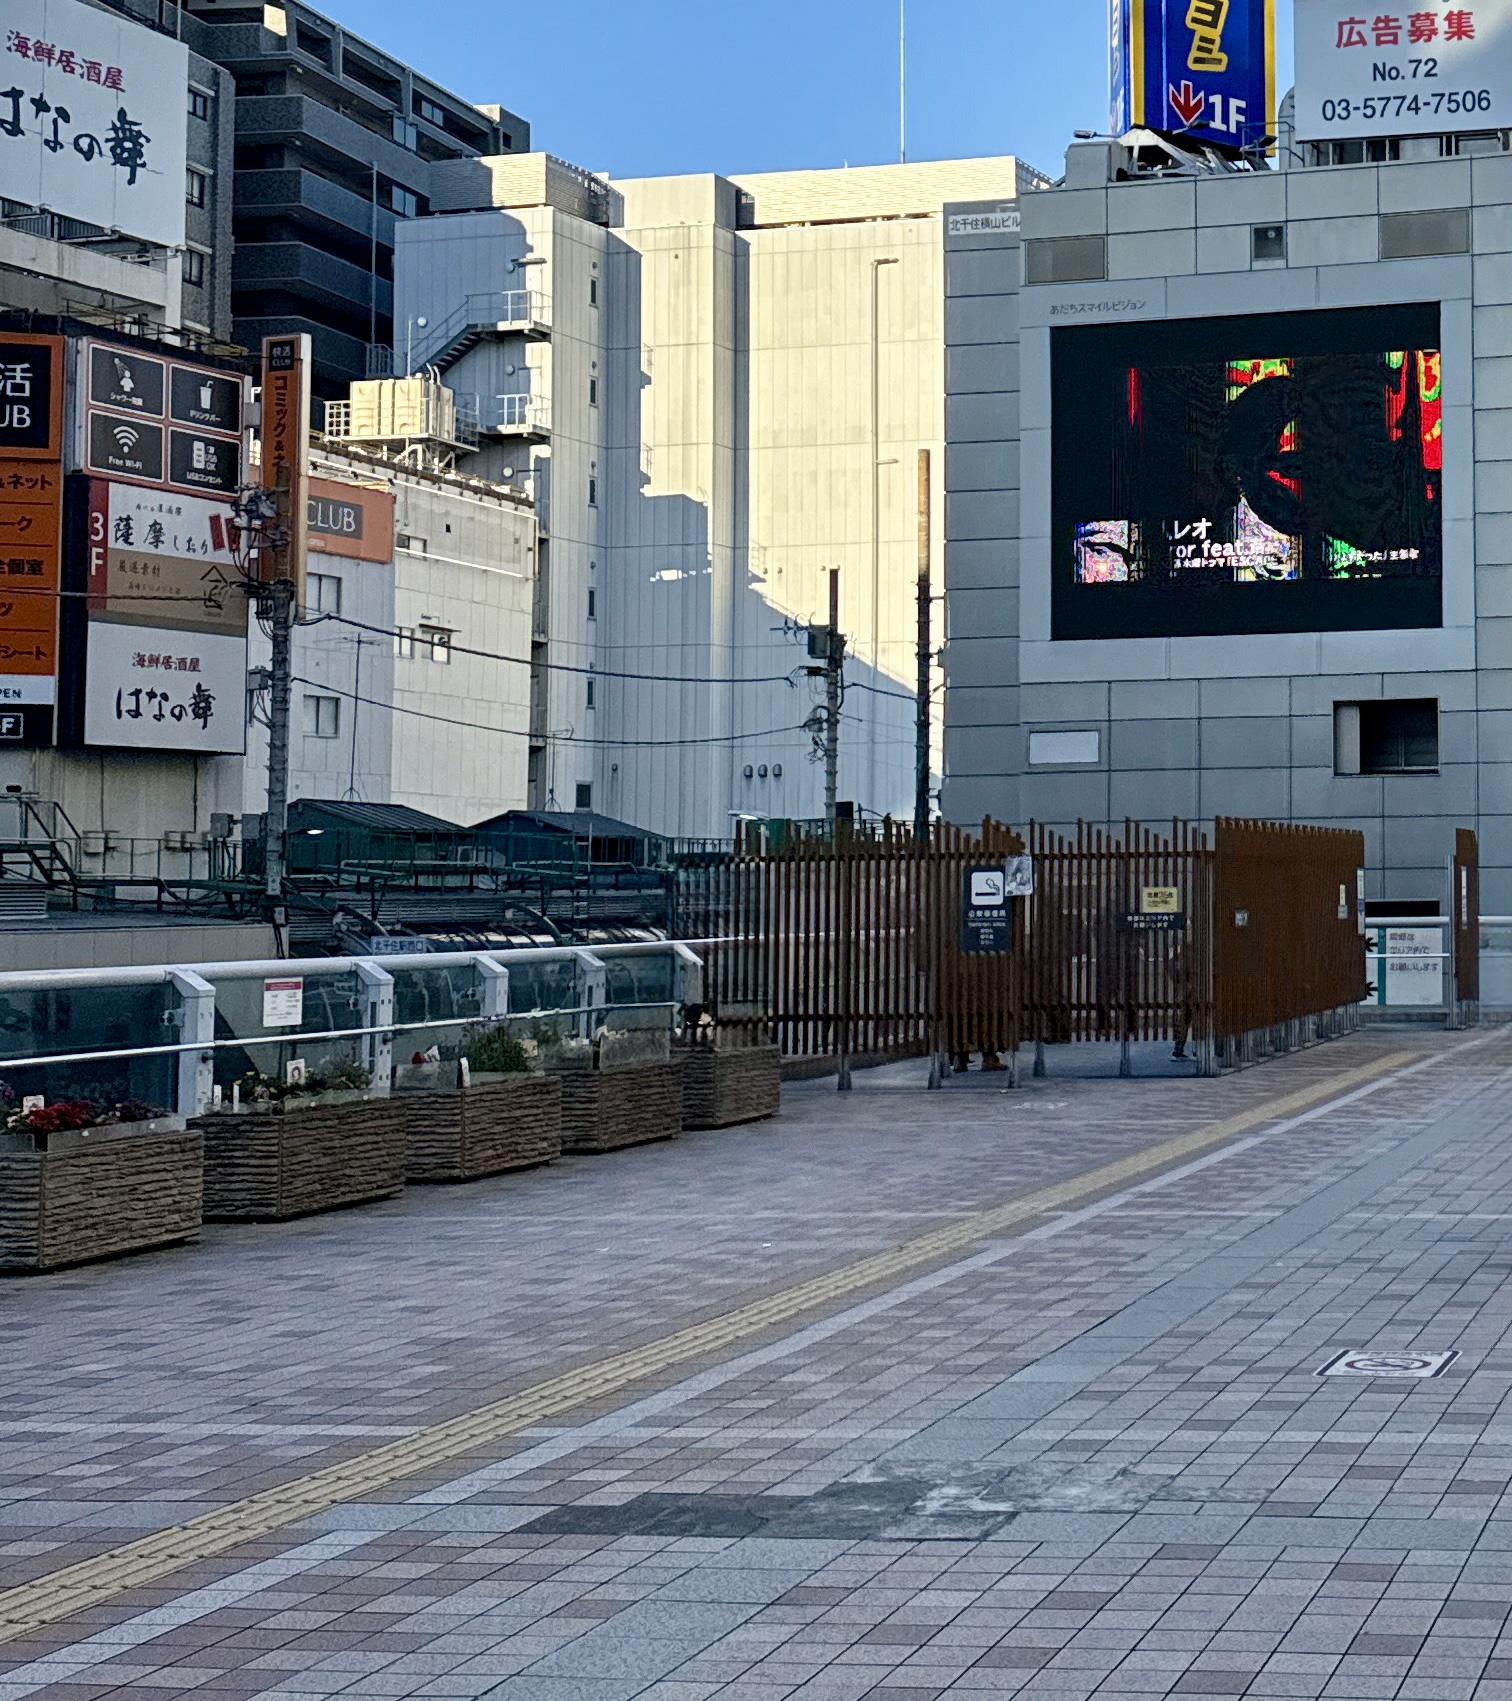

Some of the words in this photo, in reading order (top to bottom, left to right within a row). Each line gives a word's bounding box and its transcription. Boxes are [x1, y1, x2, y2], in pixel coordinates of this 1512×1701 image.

[1335, 10, 1476, 49] 広告募集
[6, 29, 126, 93] 海鮮居酒屋
[1372, 57, 1439, 82] No.72
[1209, 94, 1247, 134] 1F
[1321, 90, 1492, 121] 03-5774-7506
[1049, 300, 1147, 315] あだちスマイルビジョン
[0, 362, 33, 397] 活
[108, 456, 124, 467] Free
[306, 499, 356, 532] CLUB
[132, 652, 201, 672] 海鮮居酒屋
